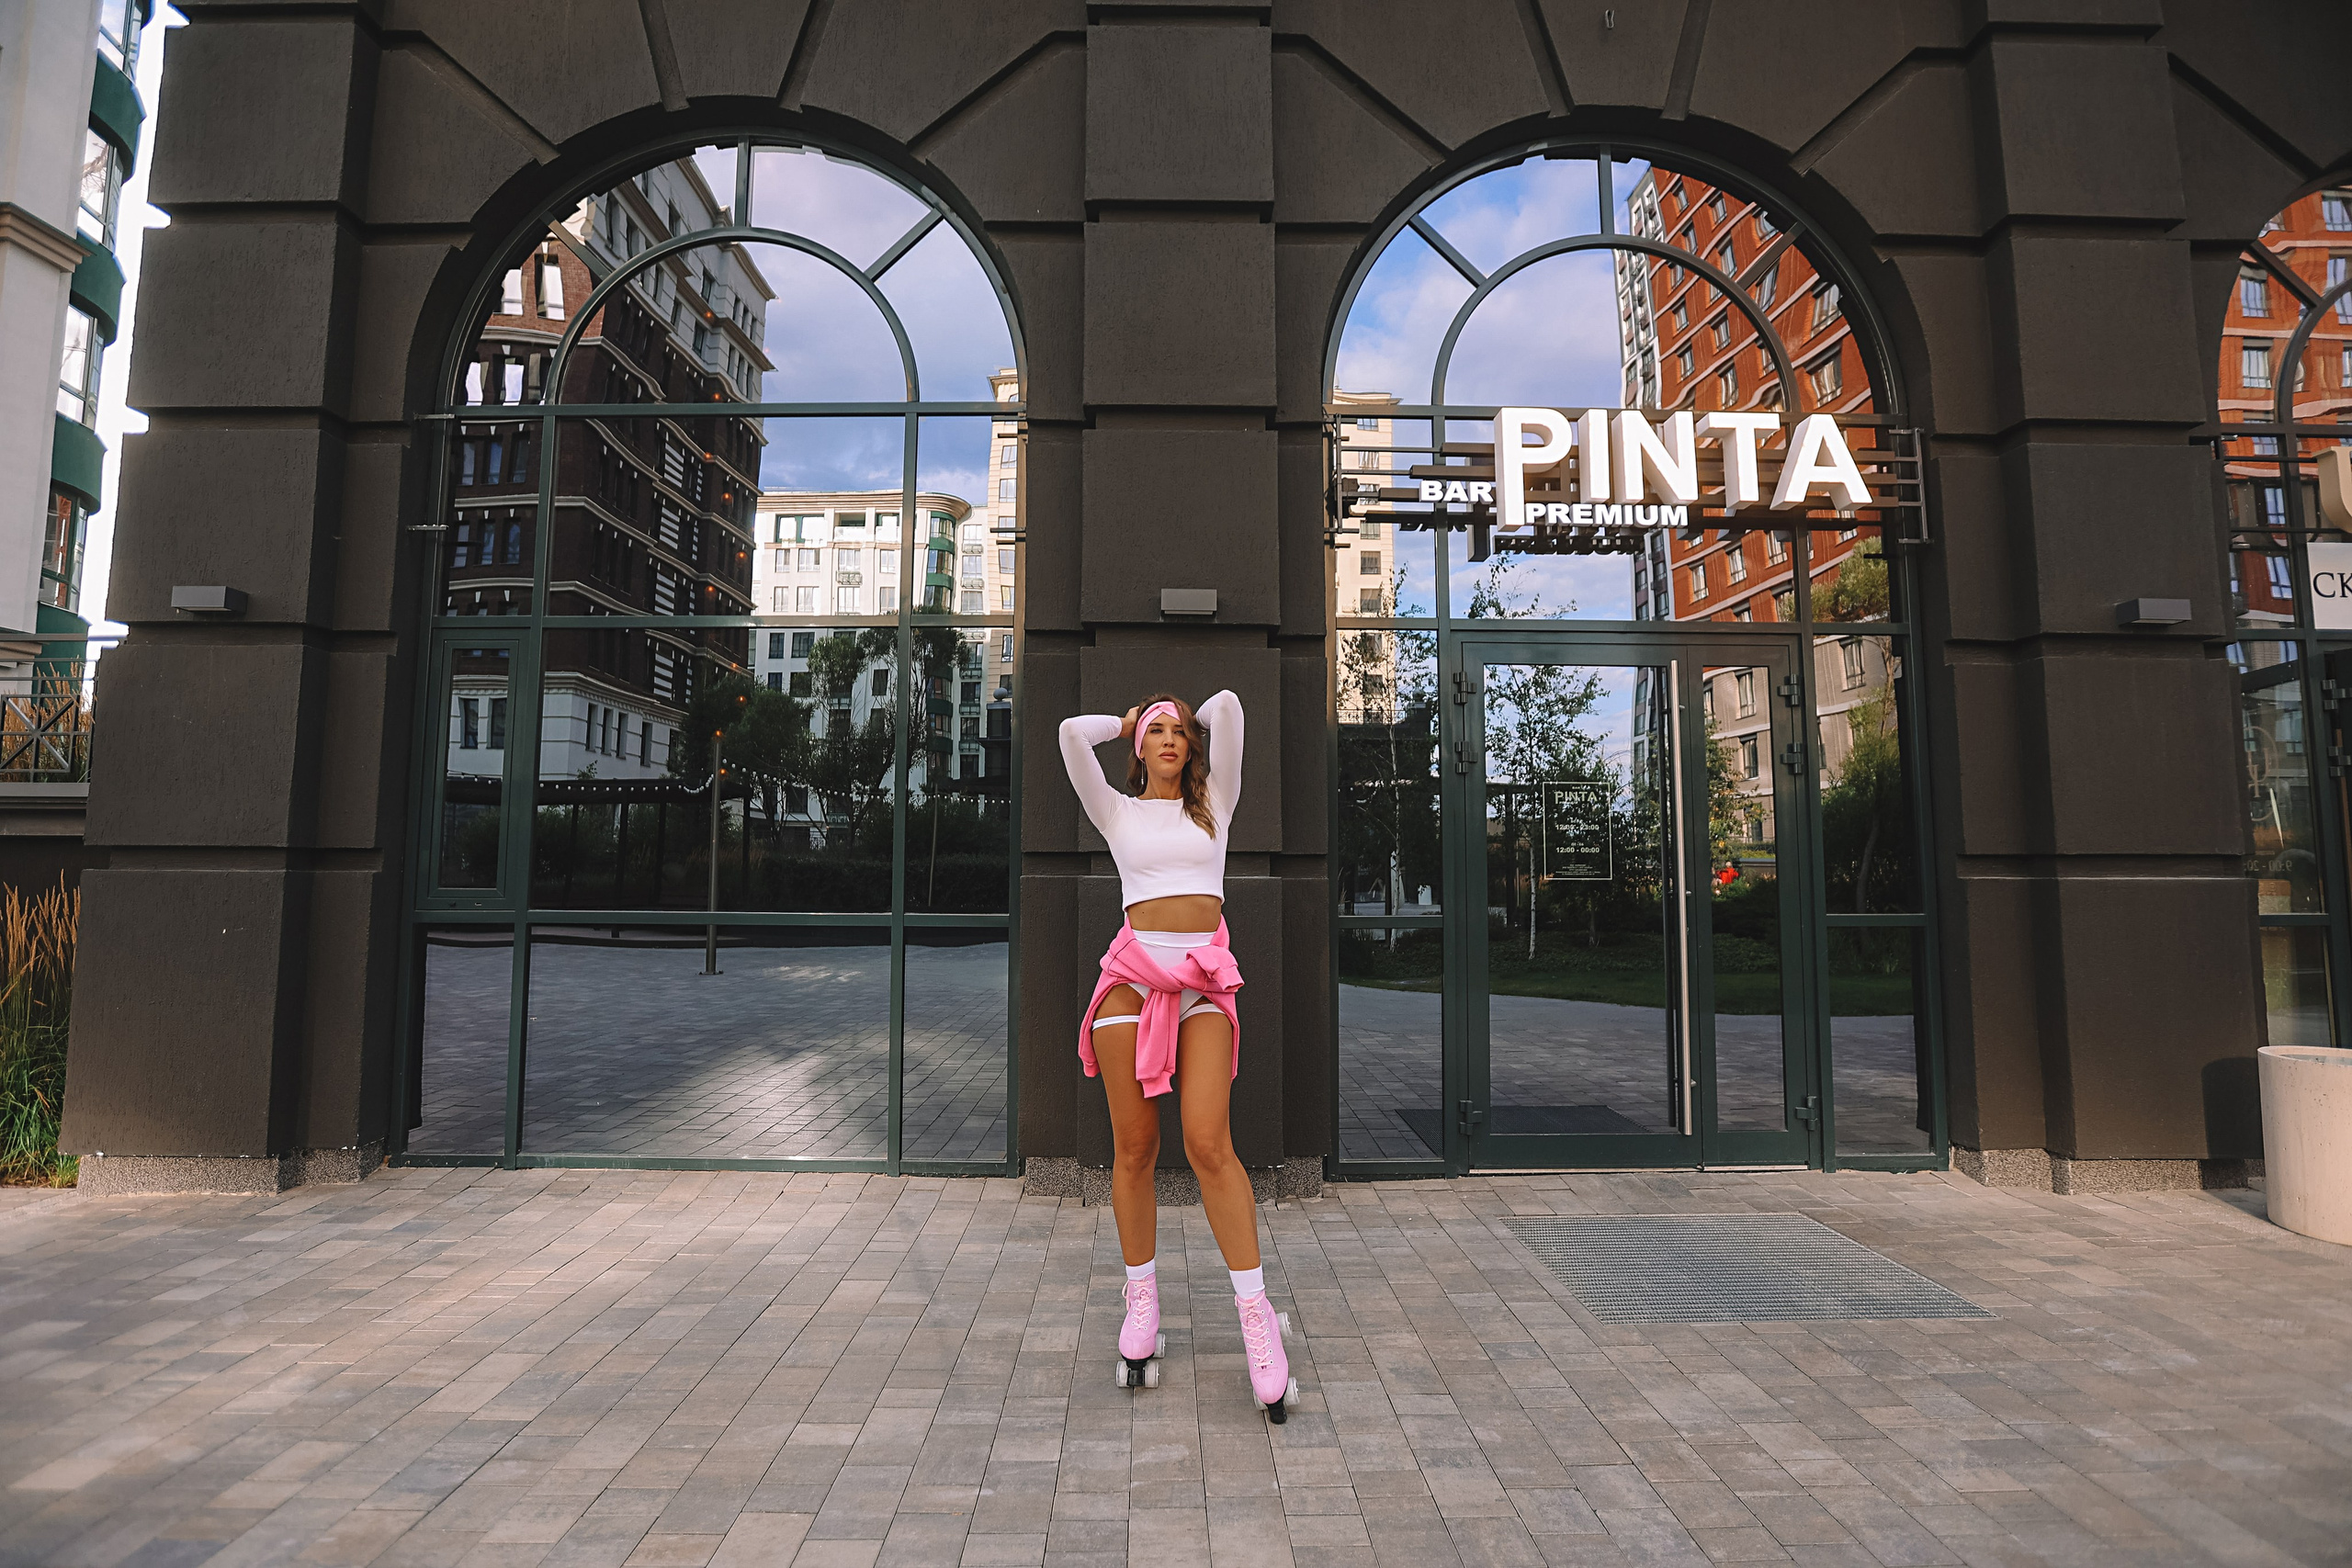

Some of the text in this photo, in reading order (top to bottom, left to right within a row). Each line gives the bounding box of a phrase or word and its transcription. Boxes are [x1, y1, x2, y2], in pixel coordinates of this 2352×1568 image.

[1494, 407, 1872, 532] PINTA
[1419, 479, 1494, 504] BAR
[1525, 502, 1689, 528] PREMIUM
[1554, 791, 1598, 804] PINTA
